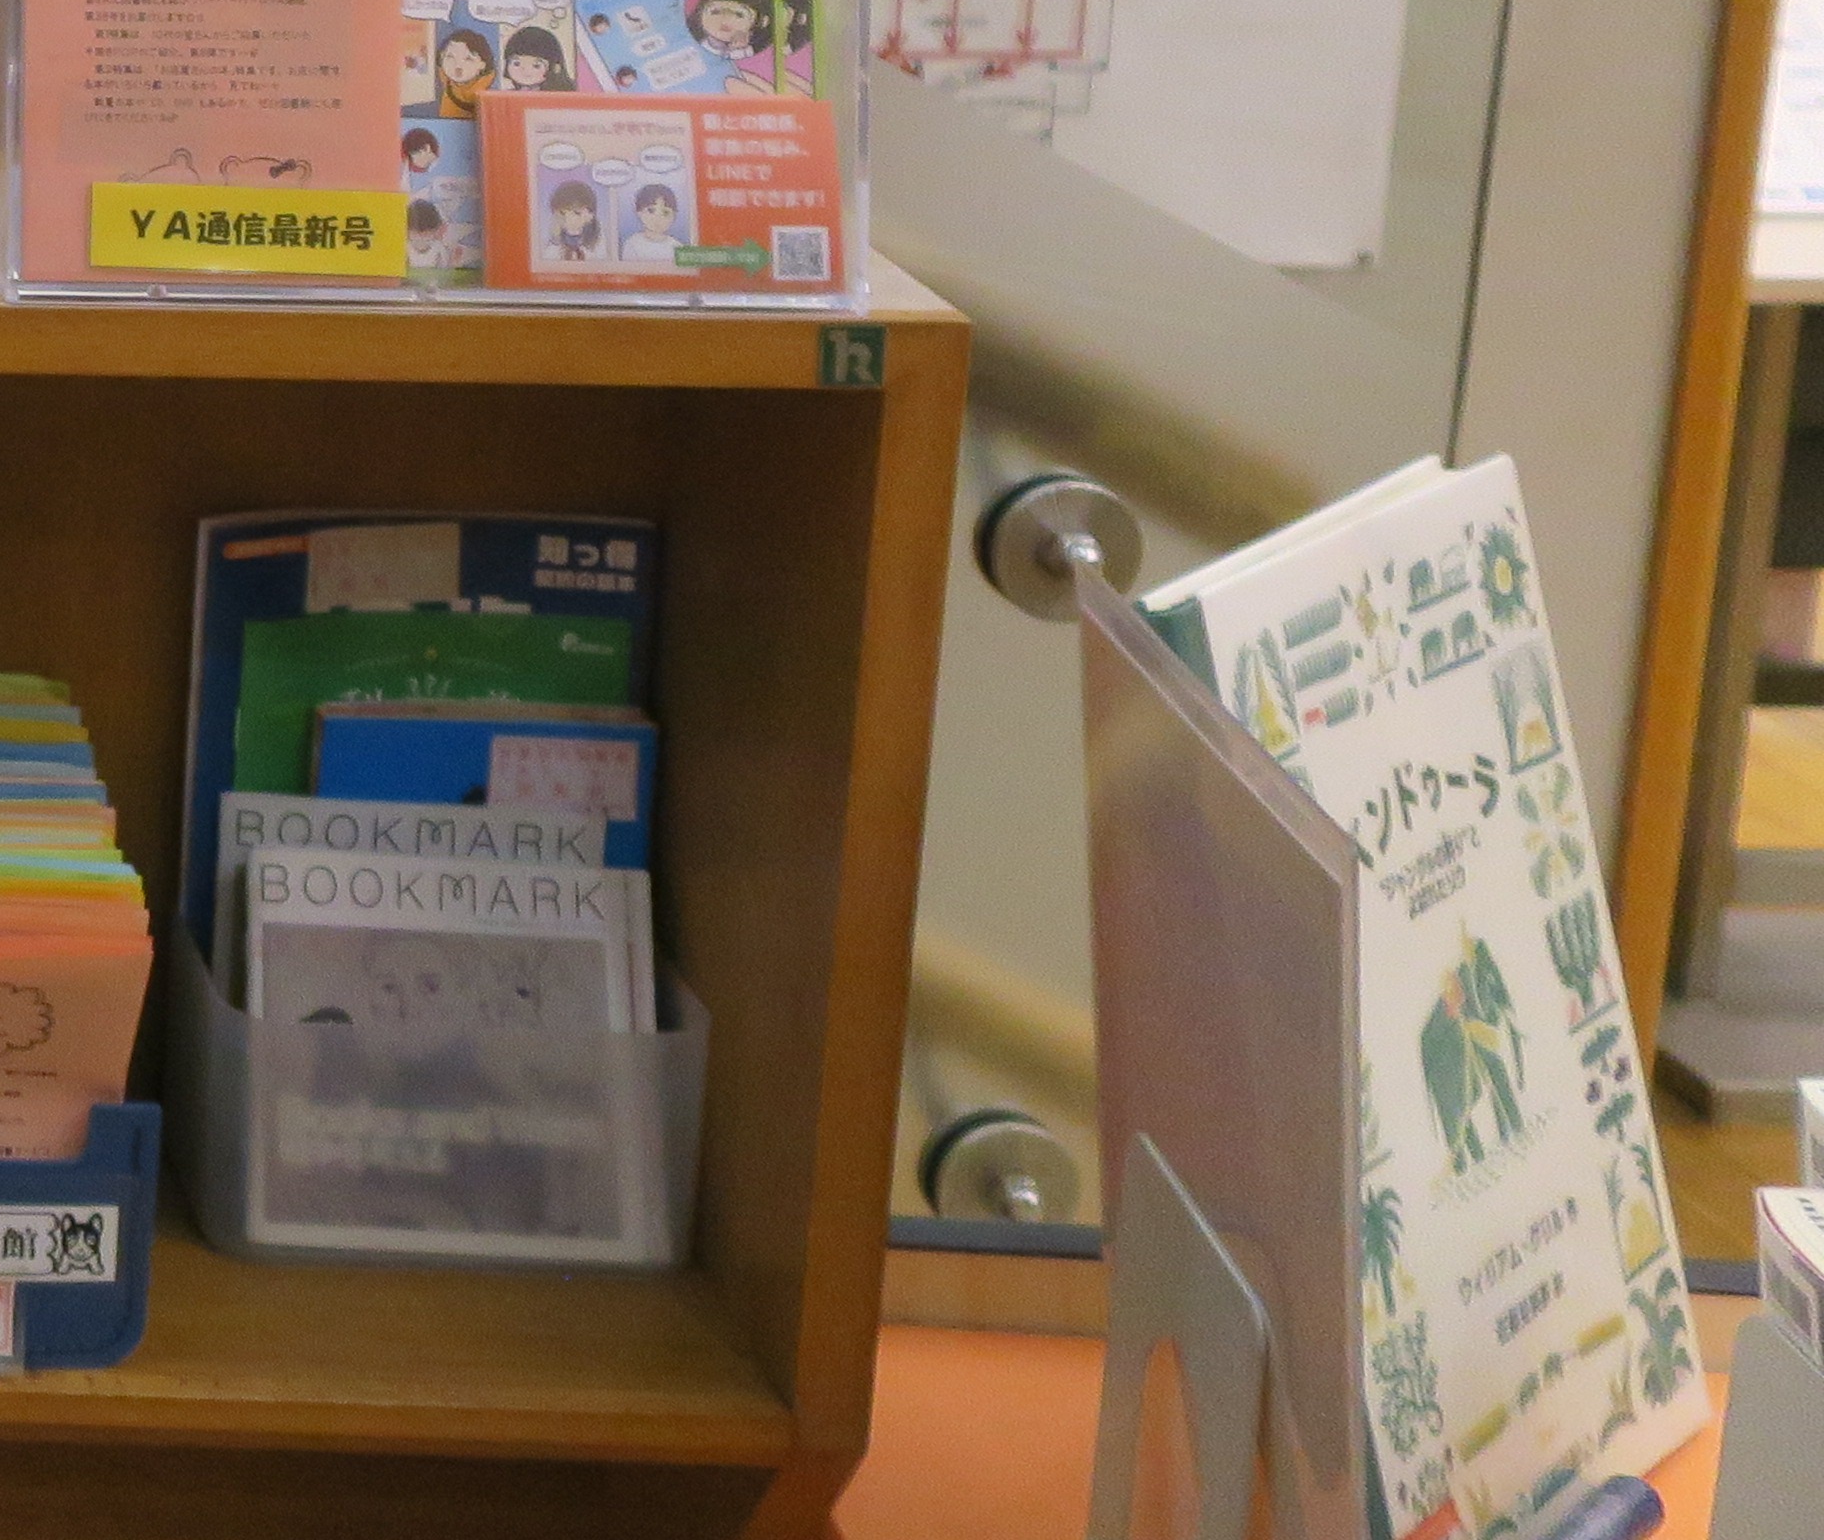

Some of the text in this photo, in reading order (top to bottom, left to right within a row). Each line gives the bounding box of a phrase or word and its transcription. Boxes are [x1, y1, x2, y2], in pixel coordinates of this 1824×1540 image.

[130, 209, 375, 250] YA通信最新号
[235, 808, 588, 864] BOOKMARK
[1353, 753, 1502, 868] ンドゥーラ
[259, 864, 605, 921] BOOKMARK
